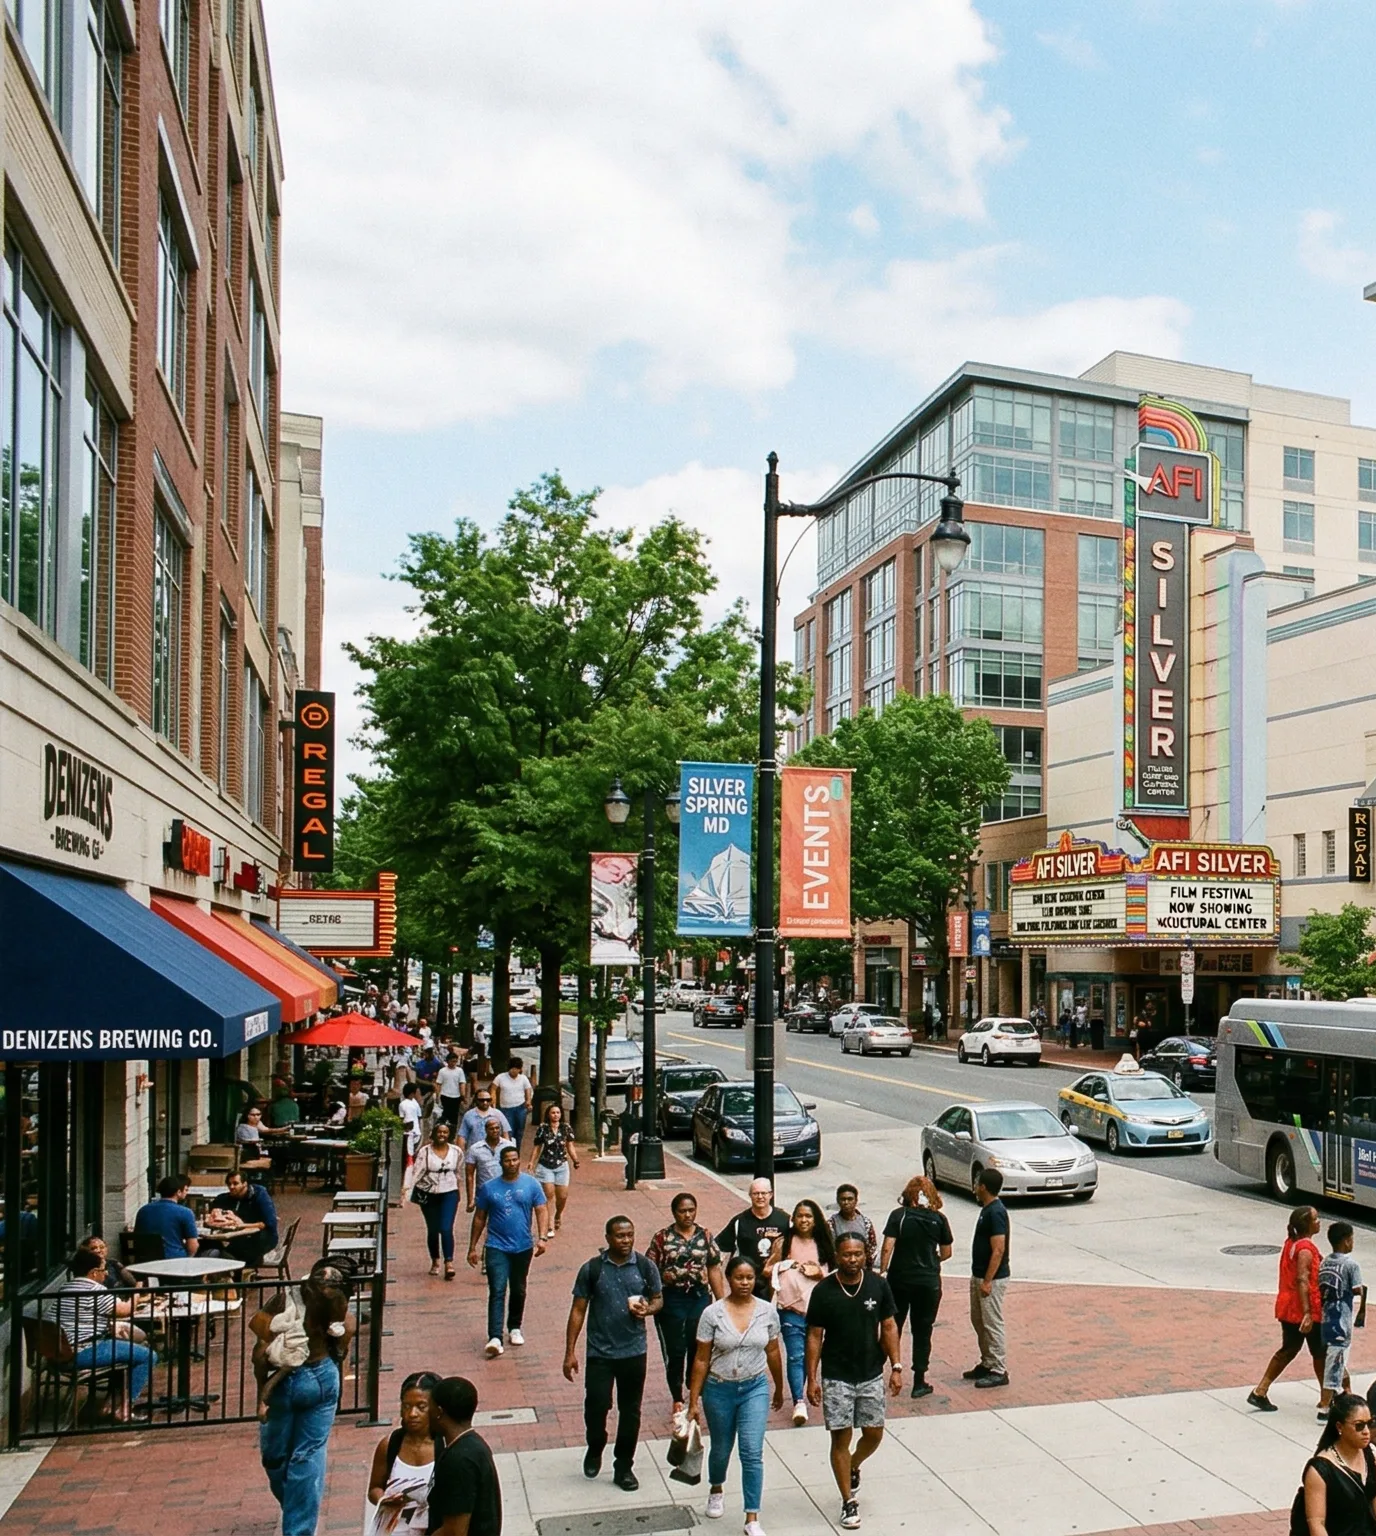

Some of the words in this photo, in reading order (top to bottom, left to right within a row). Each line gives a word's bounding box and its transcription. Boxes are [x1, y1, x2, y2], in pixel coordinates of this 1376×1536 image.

[1147, 463, 1202, 501] AFI
[1149, 540, 1177, 758] SILVER
[44, 742, 113, 842] DENIZENS
[688, 777, 745, 796] SILVER
[303, 743, 328, 860] REGAL
[685, 796, 748, 815] SPRING
[703, 816, 730, 834] MD
[803, 785, 831, 910] EVENTS
[1354, 813, 1367, 877] REGAL
[1036, 856, 1055, 880] AFI
[1056, 851, 1096, 878] SILVER
[1156, 850, 1190, 871] AFI
[1197, 852, 1266, 874] SILVER
[1170, 886, 1197, 898] FILM
[1202, 887, 1254, 900] FESTIVAL
[1169, 902, 1195, 914] NOW
[1200, 902, 1253, 914] SHOWING
[1224, 917, 1267, 929] CENTER
[3, 1029, 94, 1050] DENIZENS
[99, 1028, 183, 1049] BREWING
[189, 1028, 218, 1048] CO.
